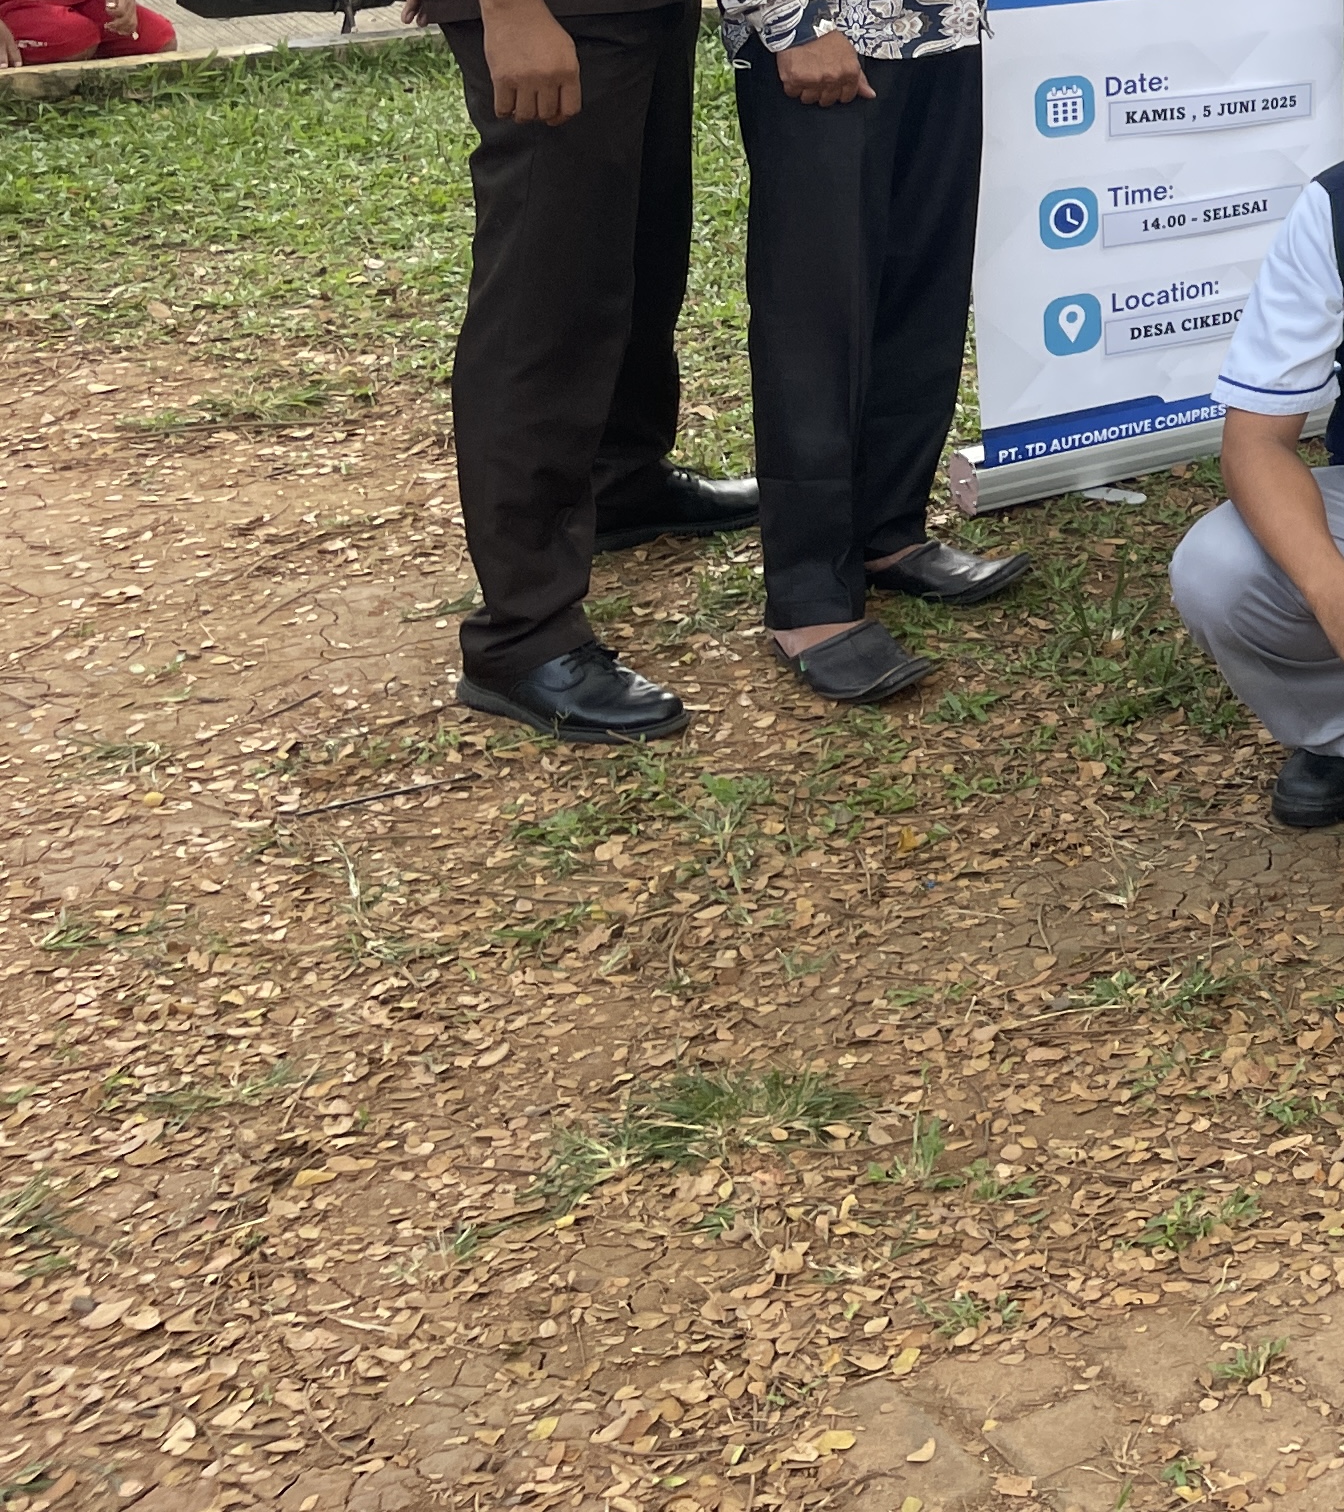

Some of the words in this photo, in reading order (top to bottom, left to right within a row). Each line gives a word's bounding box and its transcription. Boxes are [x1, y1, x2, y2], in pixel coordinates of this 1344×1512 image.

[1105, 72, 1169, 97] Date:
[1125, 106, 1185, 125] KAMIS
[1203, 105, 1212, 118] 5
[1218, 99, 1257, 117] JUNI
[1261, 95, 1298, 111] 2025
[1108, 184, 1174, 208] Time:
[1141, 213, 1187, 232] 14.00
[1203, 199, 1269, 223] SELESAI
[1111, 278, 1220, 314] Location:
[1130, 321, 1175, 341] DESA
[998, 447, 1023, 463] PT.
[1025, 442, 1047, 456] TD
[1050, 418, 1152, 453] AUTOMOTIVE
[1154, 404, 1227, 430] COMPRES
